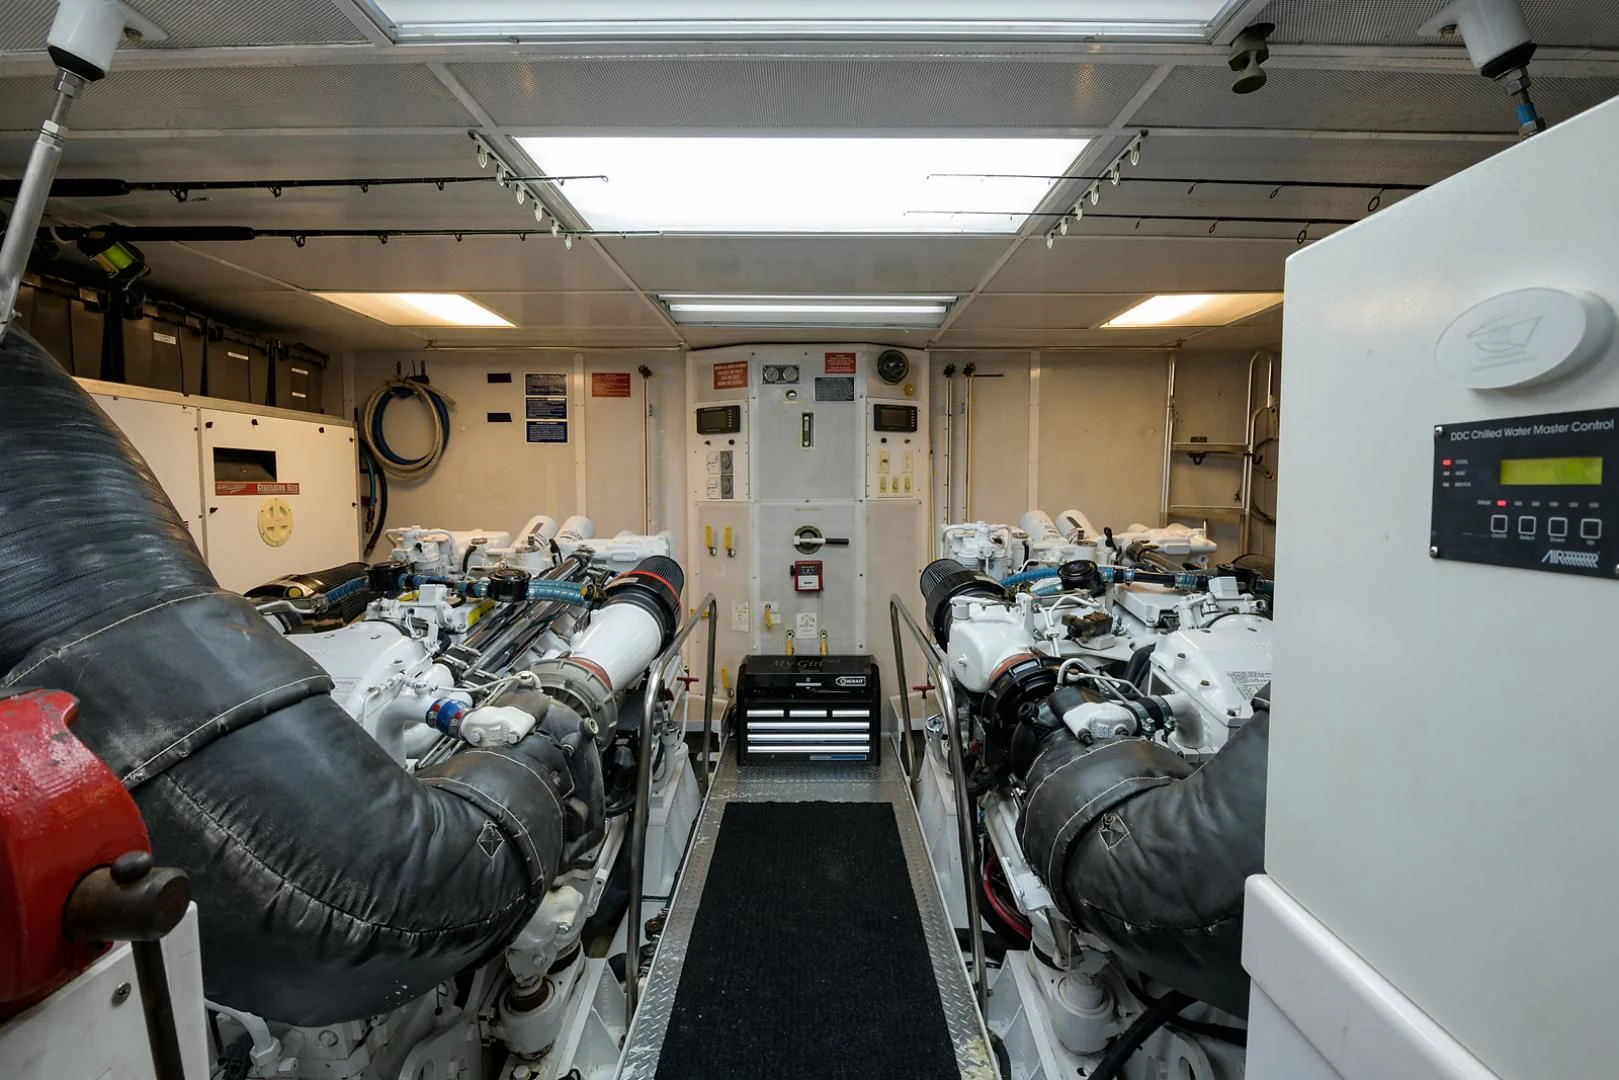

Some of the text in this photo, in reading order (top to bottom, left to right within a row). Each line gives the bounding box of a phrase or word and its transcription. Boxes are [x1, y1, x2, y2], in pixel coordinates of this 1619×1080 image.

[1450, 419, 1615, 441] DDC Chilled Water Master Control
